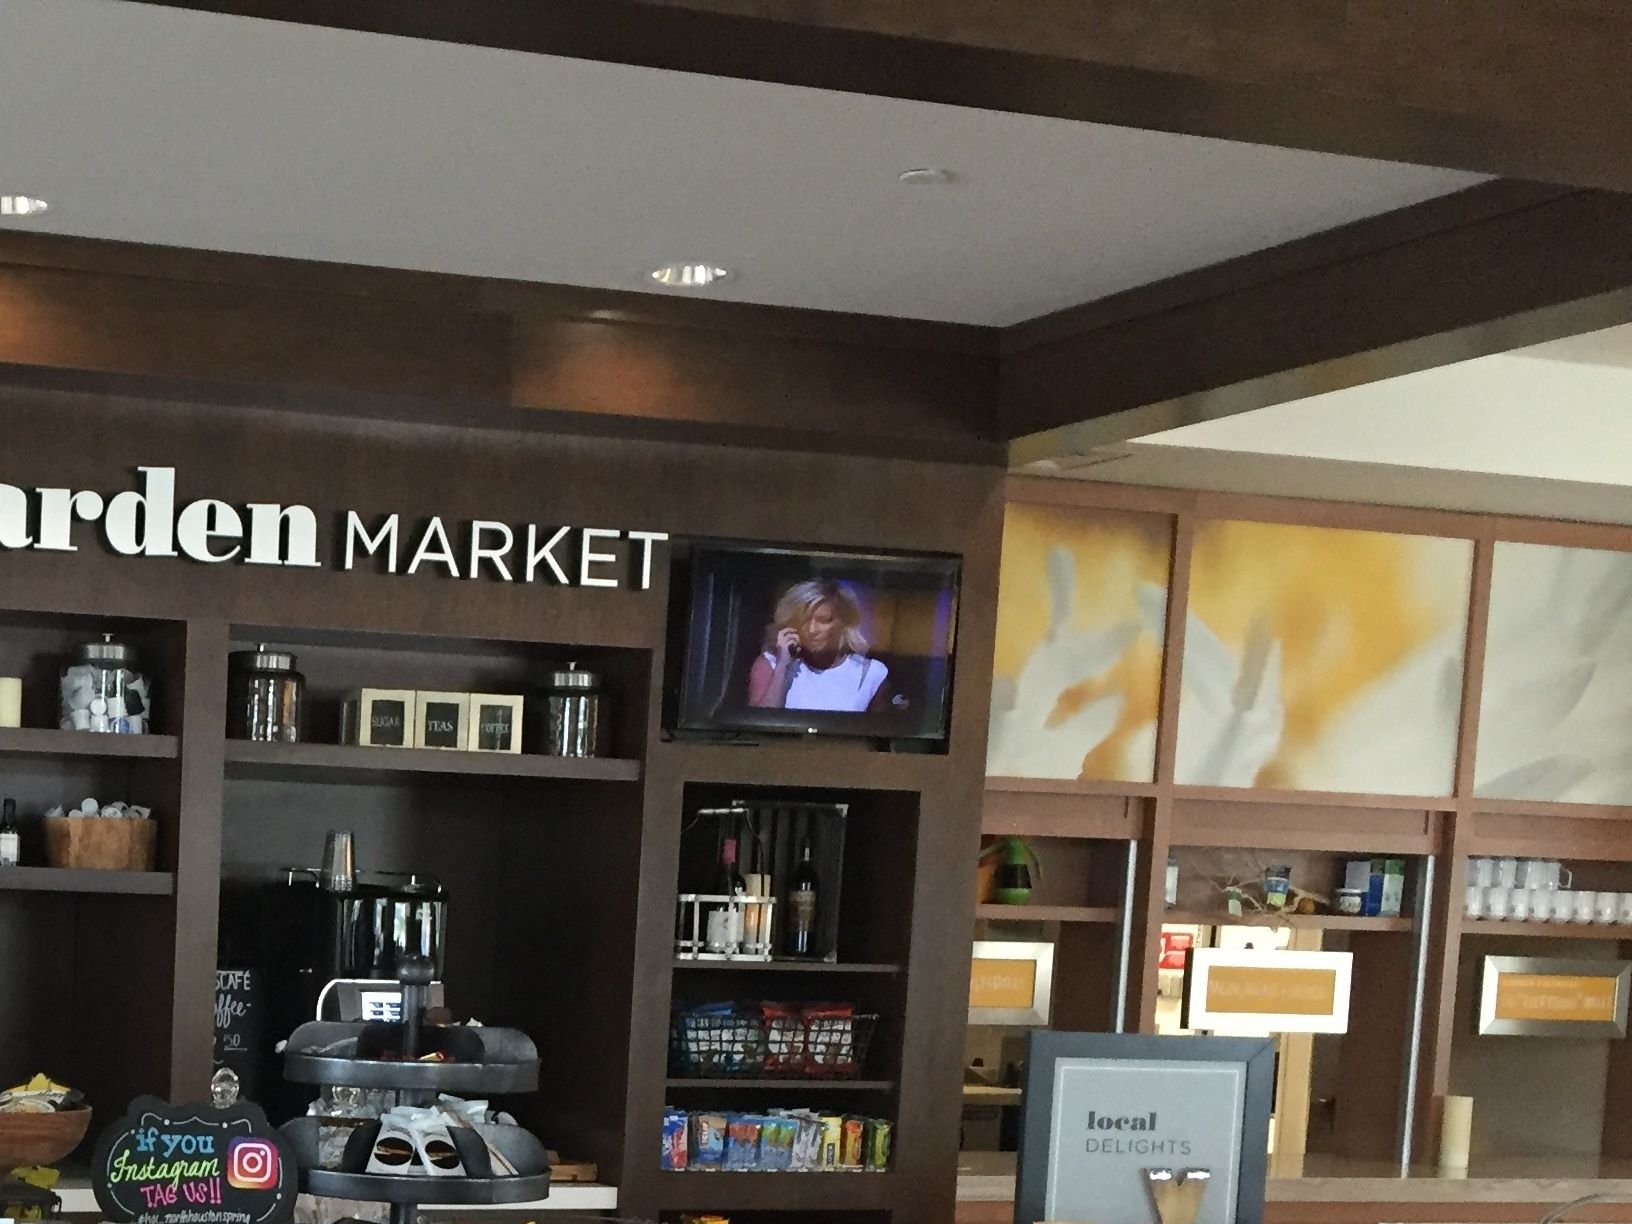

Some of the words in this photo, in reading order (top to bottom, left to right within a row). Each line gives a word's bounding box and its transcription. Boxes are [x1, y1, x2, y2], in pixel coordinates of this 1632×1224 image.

[346, 512, 669, 591] MARKET
[428, 720, 454, 733] TEAS
[1086, 1110, 1158, 1132] local
[135, 1127, 159, 1152] if
[159, 1134, 215, 1158] you
[1085, 1137, 1192, 1157] DELIGHTS
[110, 1149, 221, 1189] Instagram
[140, 1185, 178, 1209] TAG
